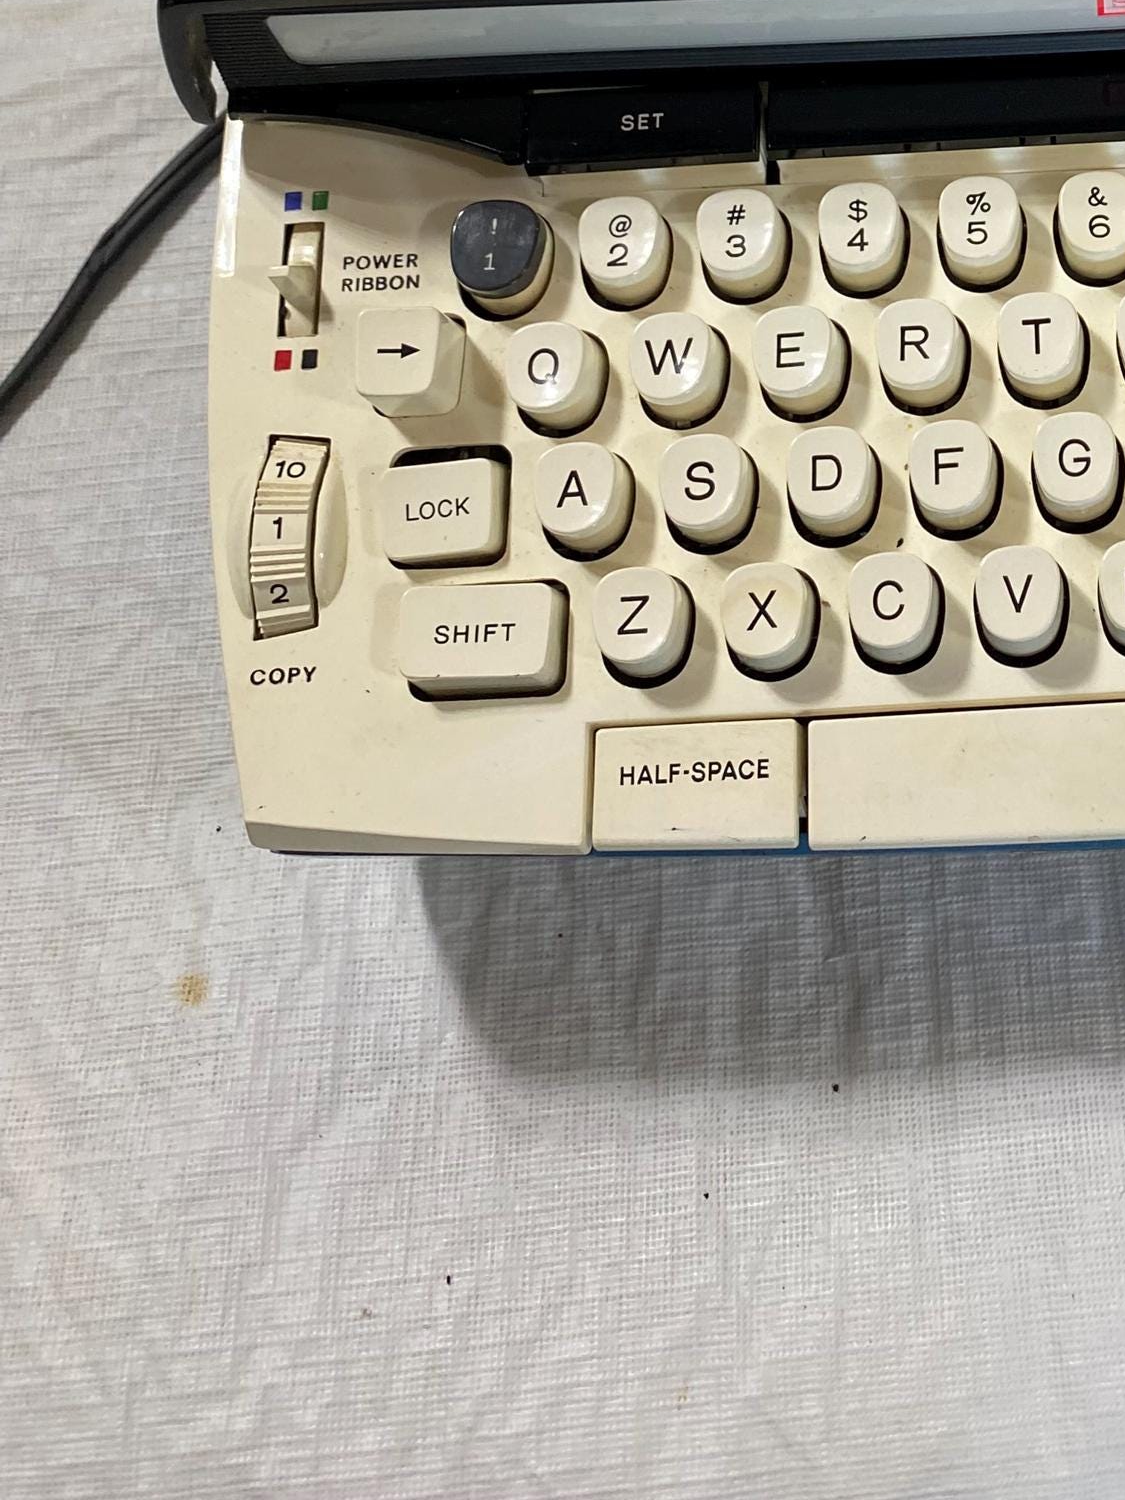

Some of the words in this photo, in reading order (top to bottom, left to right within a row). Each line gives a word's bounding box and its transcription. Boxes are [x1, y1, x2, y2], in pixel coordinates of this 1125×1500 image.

[620, 112, 664, 131] SET
[965, 191, 991, 216] %
[1087, 186, 1108, 207] &
[726, 204, 746, 226] #
[847, 199, 868, 223] $
[608, 214, 633, 238] @
[966, 220, 988, 245] 5
[1088, 214, 1111, 239] 6
[725, 234, 747, 258] 3
[847, 227, 869, 252] 4
[343, 253, 418, 270] POWER
[481, 251, 498, 272] 1
[606, 243, 629, 267] 2
[341, 274, 420, 292] RIBBON
[899, 325, 930, 362] R
[1021, 317, 1052, 355] T
[644, 337, 693, 376] W
[776, 331, 805, 369] E
[527, 348, 559, 385] Q
[275, 460, 306, 479] 10
[934, 446, 964, 486] F
[1058, 438, 1091, 478] G
[684, 461, 716, 501] S
[811, 454, 843, 492] D
[556, 470, 588, 509] A
[405, 496, 470, 522] LOCK
[272, 516, 283, 540] 1
[270, 583, 290, 605] 2
[872, 580, 905, 621] C
[1002, 574, 1033, 613] V
[617, 595, 650, 636] Z
[746, 589, 778, 631] X
[433, 623, 516, 645] SHIFT
[249, 666, 317, 686] COPY
[619, 758, 770, 786] HALF-SPACE
